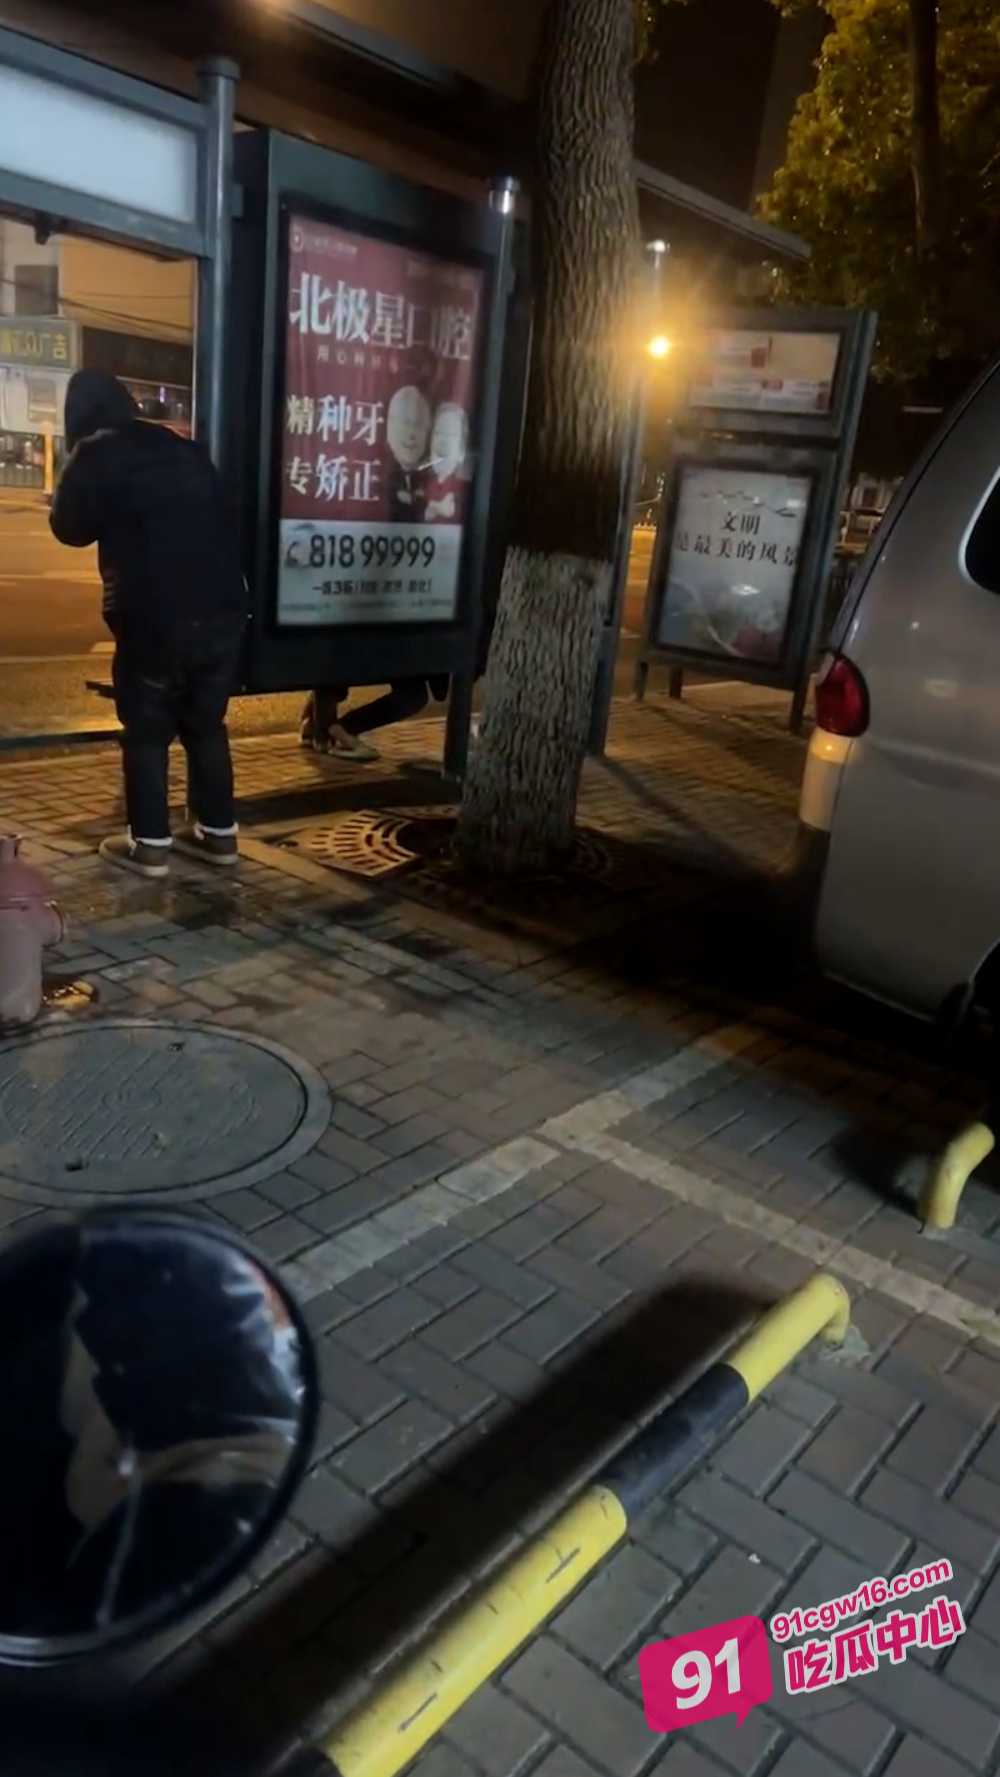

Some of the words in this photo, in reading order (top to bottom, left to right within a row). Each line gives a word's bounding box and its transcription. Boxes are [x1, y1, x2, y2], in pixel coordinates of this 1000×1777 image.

[286, 394, 385, 447] 精种牙
[286, 453, 382, 502] 专矫正
[722, 511, 760, 535] 文明
